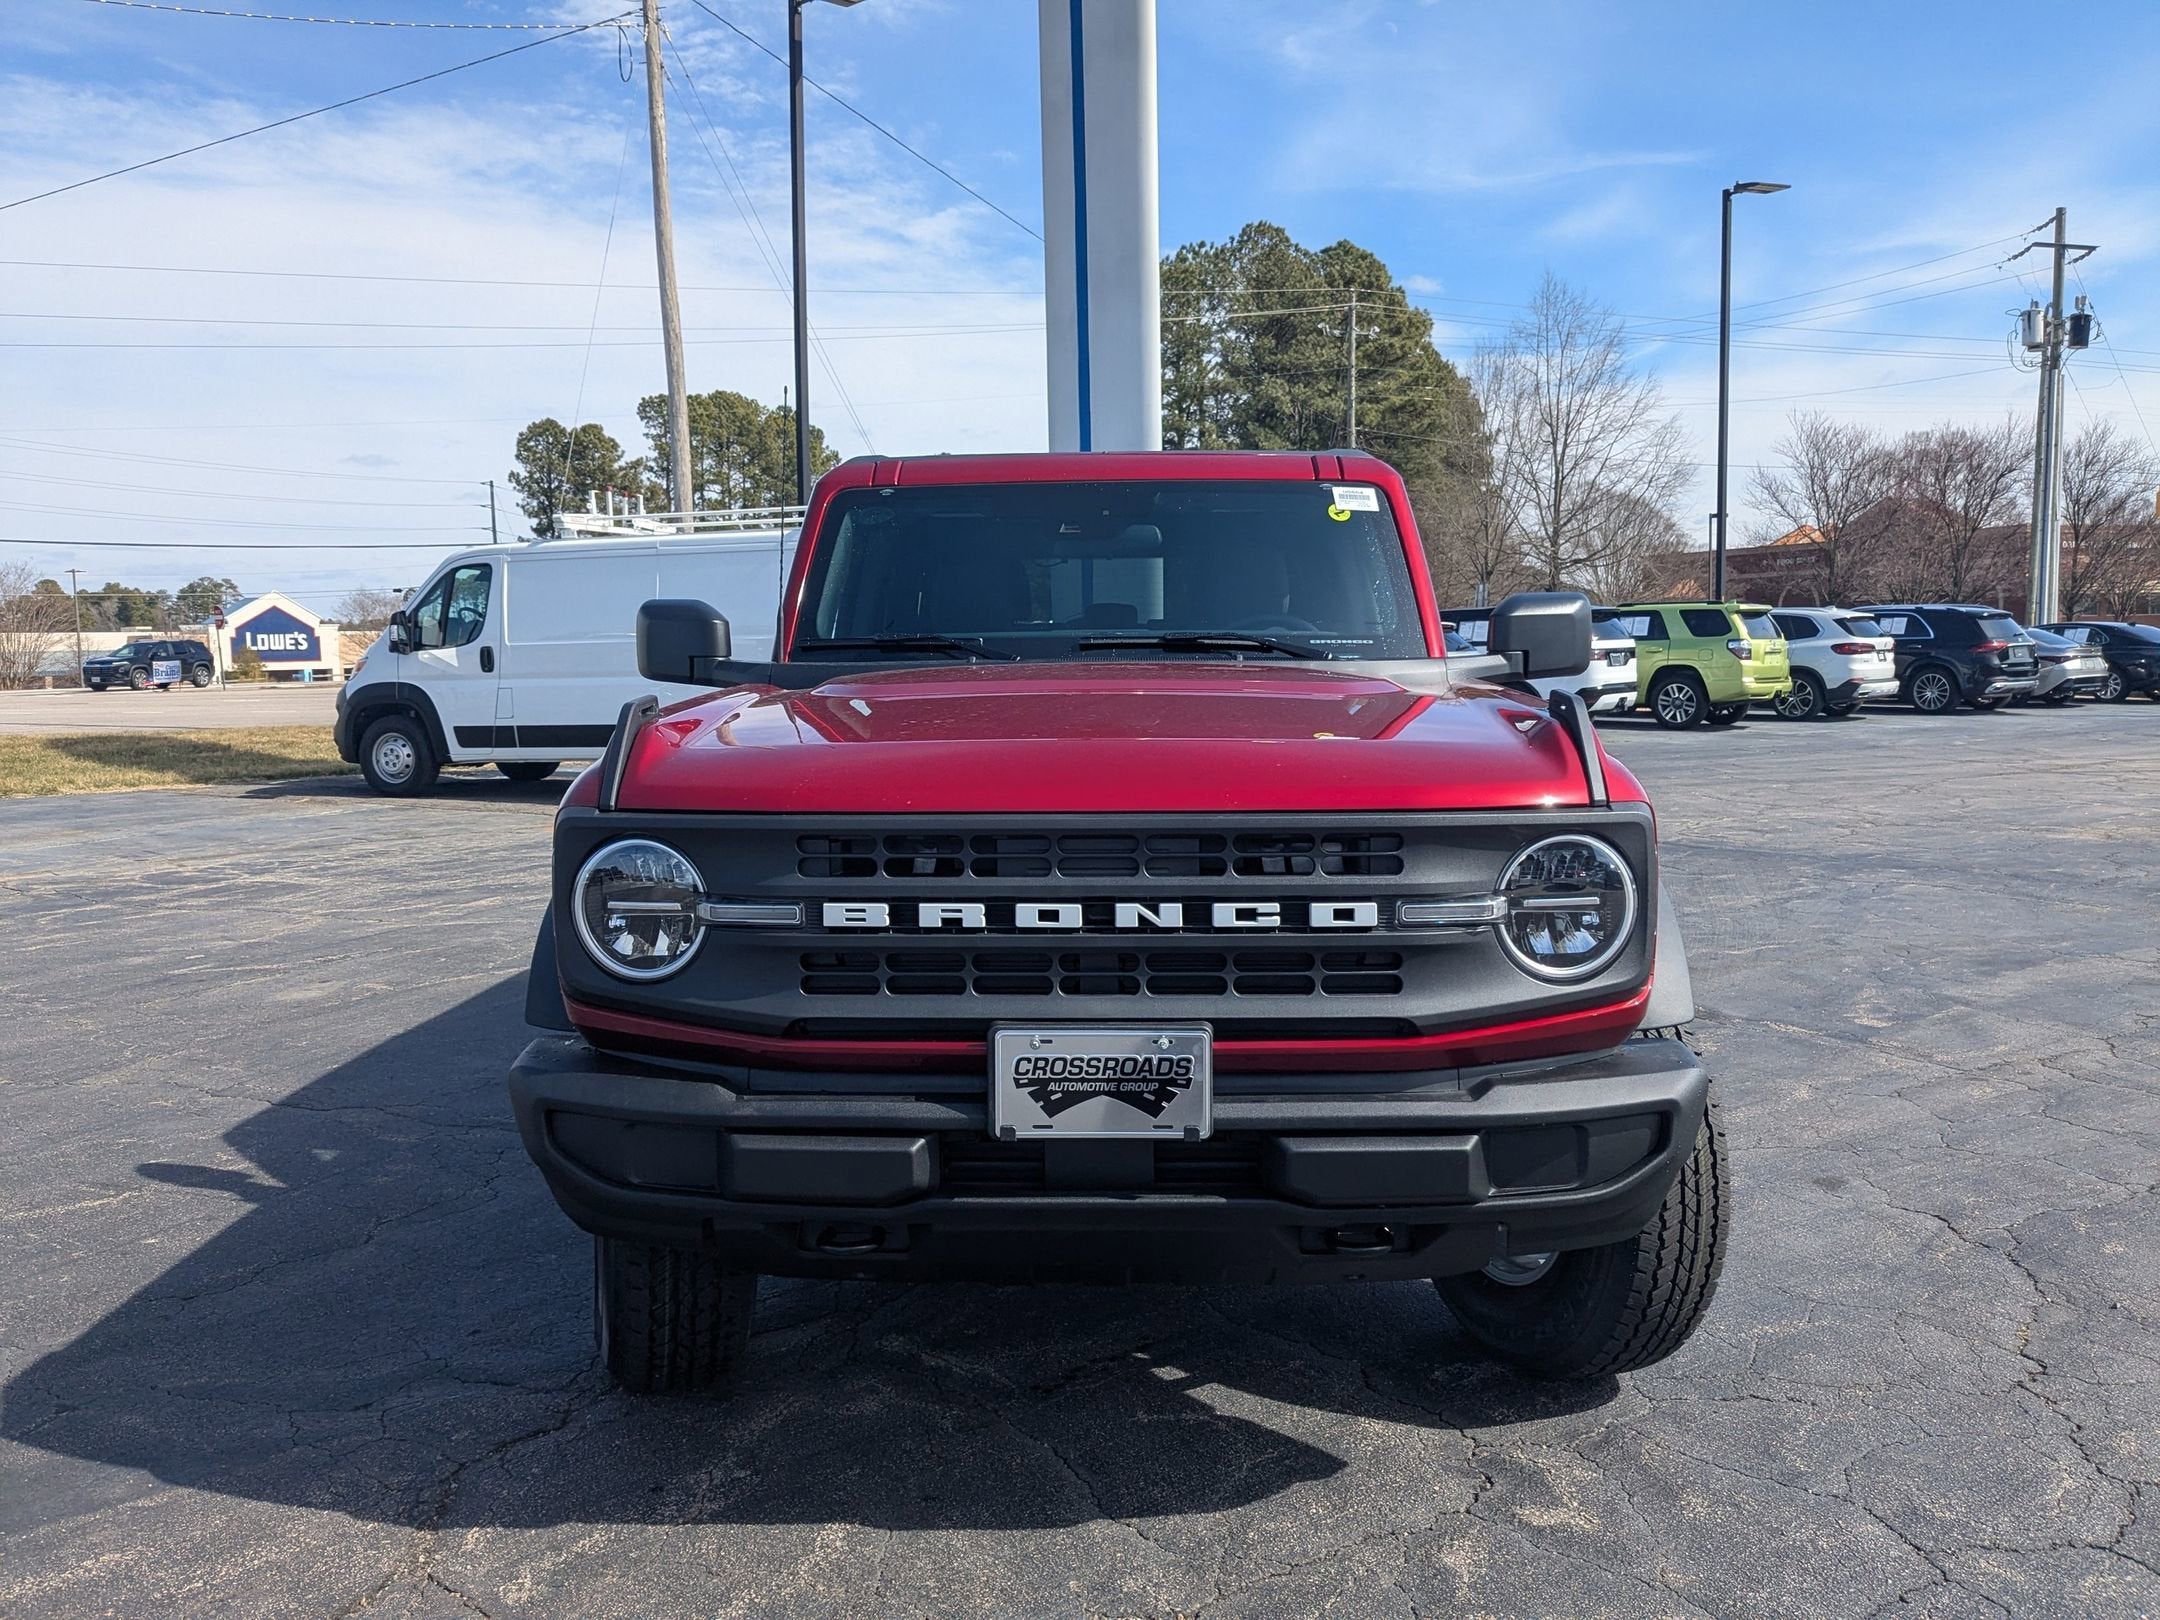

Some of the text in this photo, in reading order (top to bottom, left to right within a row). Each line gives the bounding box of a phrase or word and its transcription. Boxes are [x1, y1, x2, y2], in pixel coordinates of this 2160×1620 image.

[245, 631, 309, 651] LOWE'S
[822, 902, 1378, 928] BRONCO
[1014, 1056, 1194, 1078] CROSSROADS
[1047, 1081, 1159, 1092] AUTOMOTIVE GROUP
